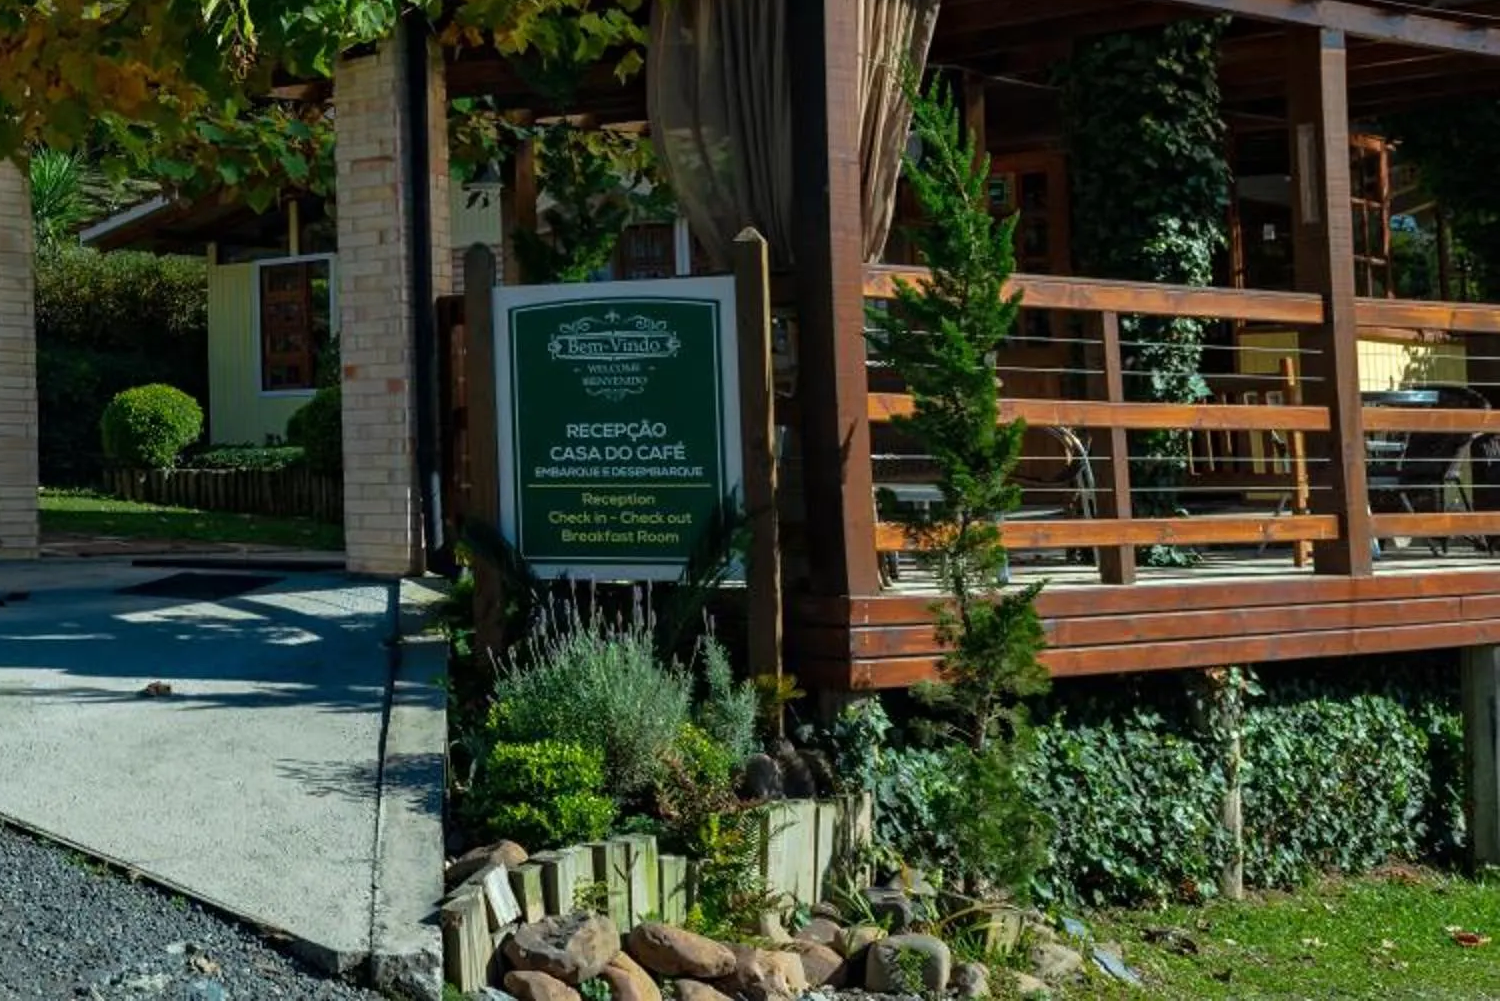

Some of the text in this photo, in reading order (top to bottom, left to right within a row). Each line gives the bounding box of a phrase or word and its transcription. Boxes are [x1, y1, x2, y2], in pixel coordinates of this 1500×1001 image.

[568, 336, 661, 353] Bem-Vindo
[566, 419, 667, 442] RECEPÇÃO
[550, 441, 687, 461] CASA DO CAFÉ
[535, 466, 703, 478] EMBARQUE E DESEMBARQUE
[581, 492, 656, 507] Reception
[548, 511, 591, 524] Check
[593, 511, 608, 524] in
[619, 511, 664, 524] Check
[666, 512, 693, 524] out
[561, 529, 680, 543] Breakfast Room
